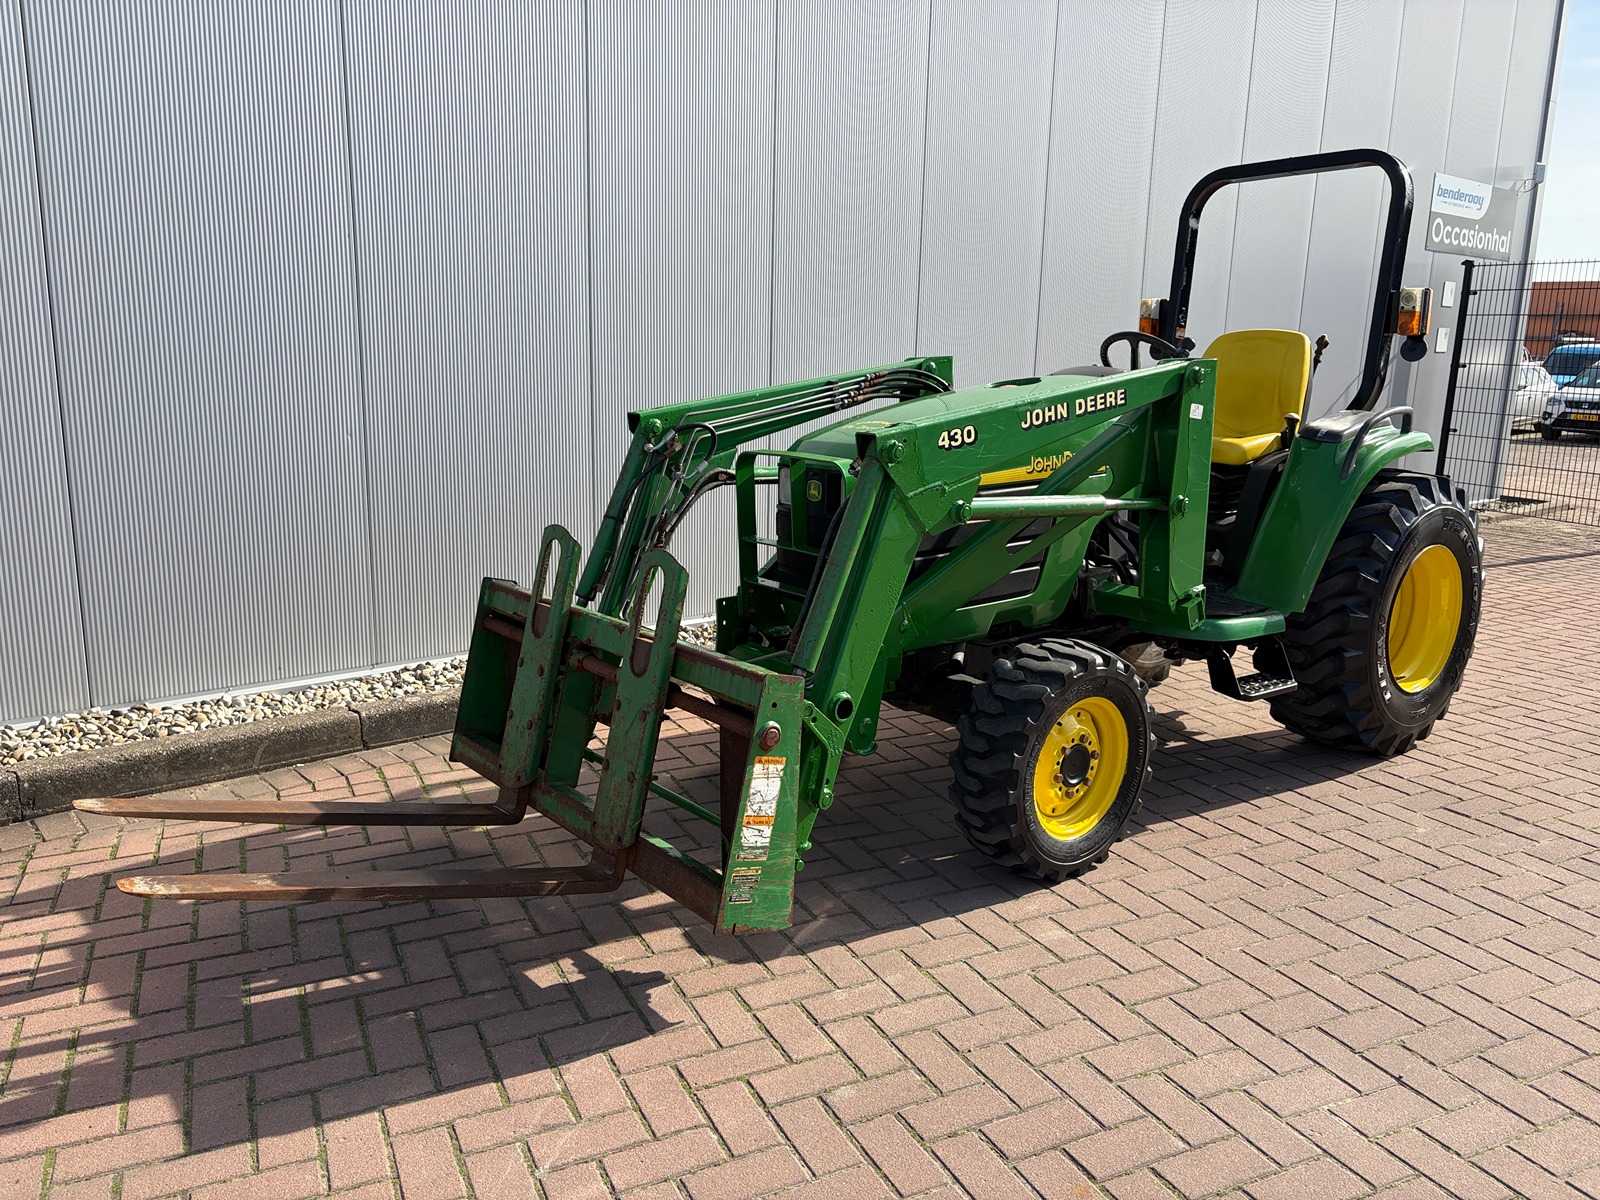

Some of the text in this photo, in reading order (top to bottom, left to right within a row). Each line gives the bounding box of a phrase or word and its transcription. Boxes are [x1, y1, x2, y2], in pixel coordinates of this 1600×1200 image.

[1432, 217, 1512, 254] Occasionhal
[1021, 388, 1127, 430] JOHN DEERE
[938, 425, 976, 450] 430
[1025, 454, 1063, 474] JOHN
